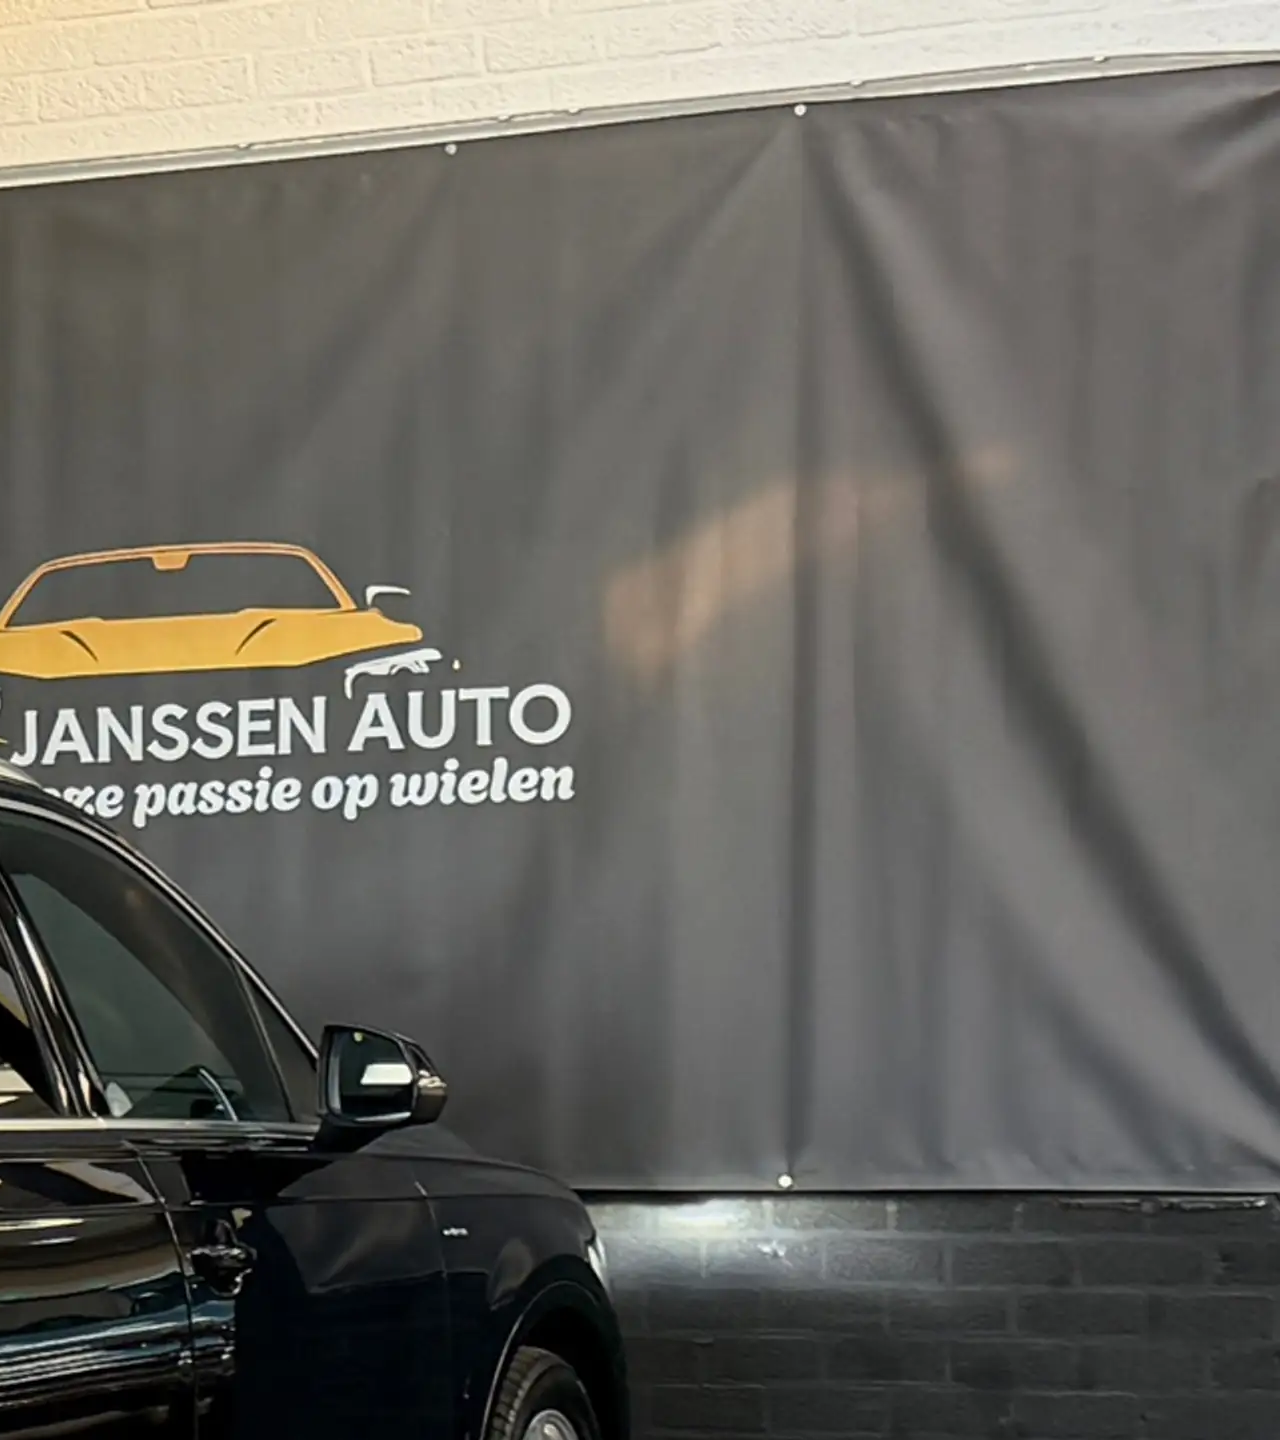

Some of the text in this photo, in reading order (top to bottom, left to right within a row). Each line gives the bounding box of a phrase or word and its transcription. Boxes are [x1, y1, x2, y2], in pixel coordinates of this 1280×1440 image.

[9, 683, 572, 768] JANSSEN AUTO
[42, 756, 576, 829] ze passie op wielen
